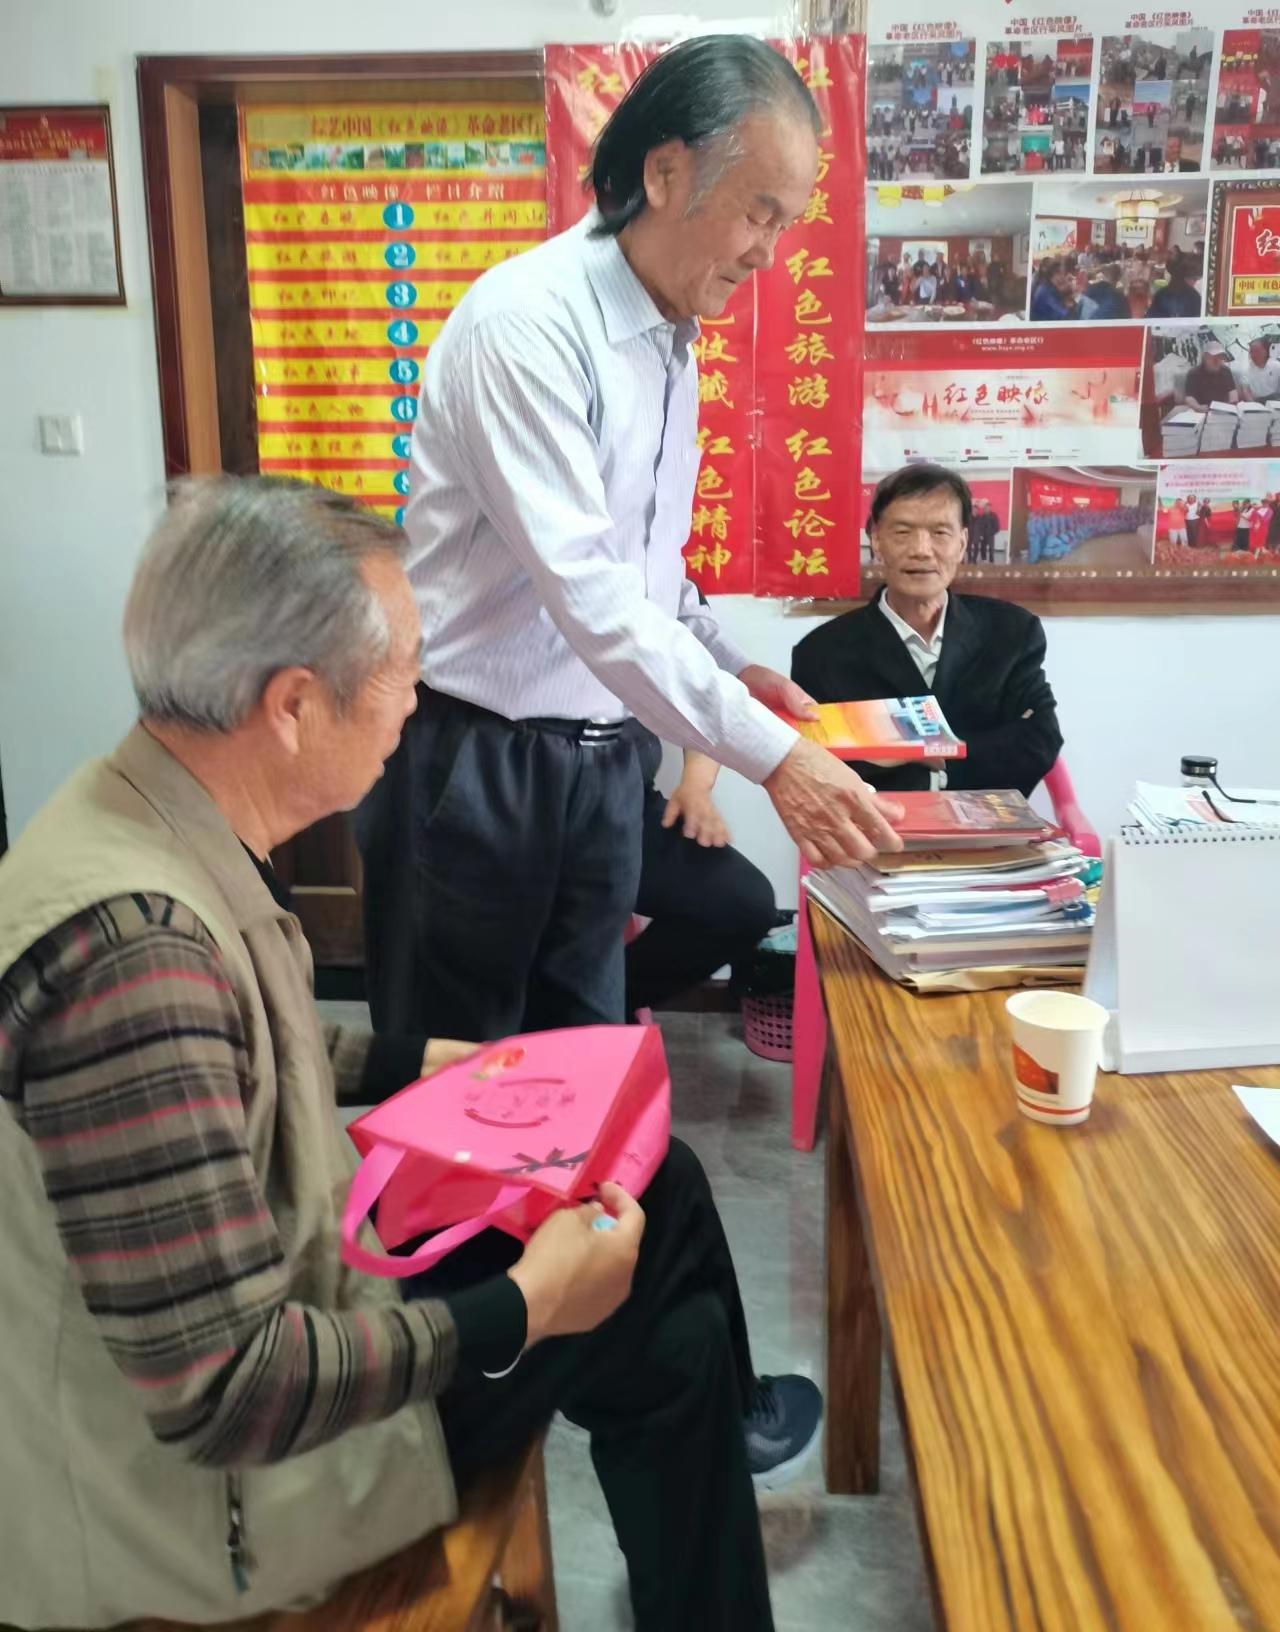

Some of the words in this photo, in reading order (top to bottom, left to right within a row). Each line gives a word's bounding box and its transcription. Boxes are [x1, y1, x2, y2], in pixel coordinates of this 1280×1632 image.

[393, 285, 410, 307] 3
[784, 246, 836, 410] 红色旅游
[943, 379, 1050, 407] 红色映像
[686, 427, 736, 582] 红色精神
[784, 427, 836, 578] 红色论坛
